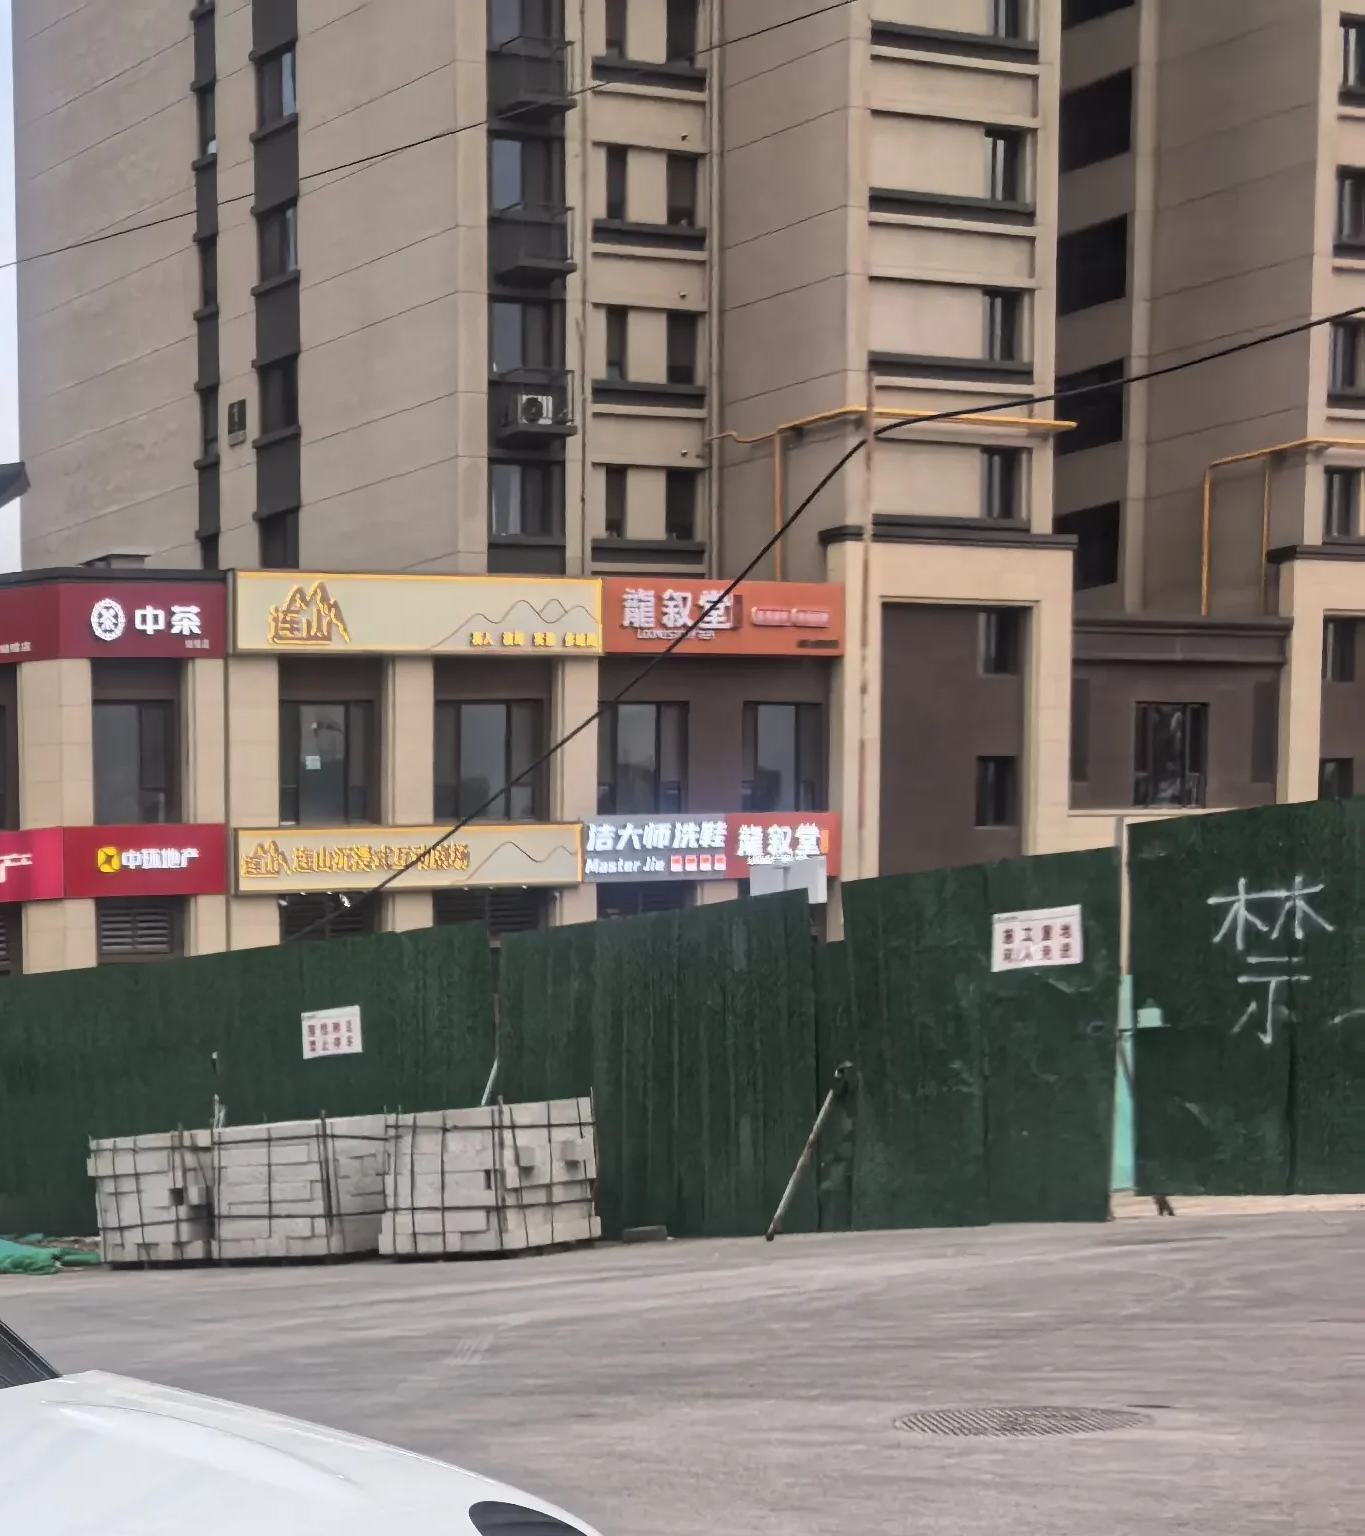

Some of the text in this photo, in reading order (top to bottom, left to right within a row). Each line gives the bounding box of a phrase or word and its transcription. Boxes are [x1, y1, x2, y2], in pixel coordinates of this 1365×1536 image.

[135, 605, 202, 636] 中茶
[585, 820, 727, 852] 洁大师洗鞋
[120, 847, 200, 870] 中环地产
[584, 857, 642, 875] Master
